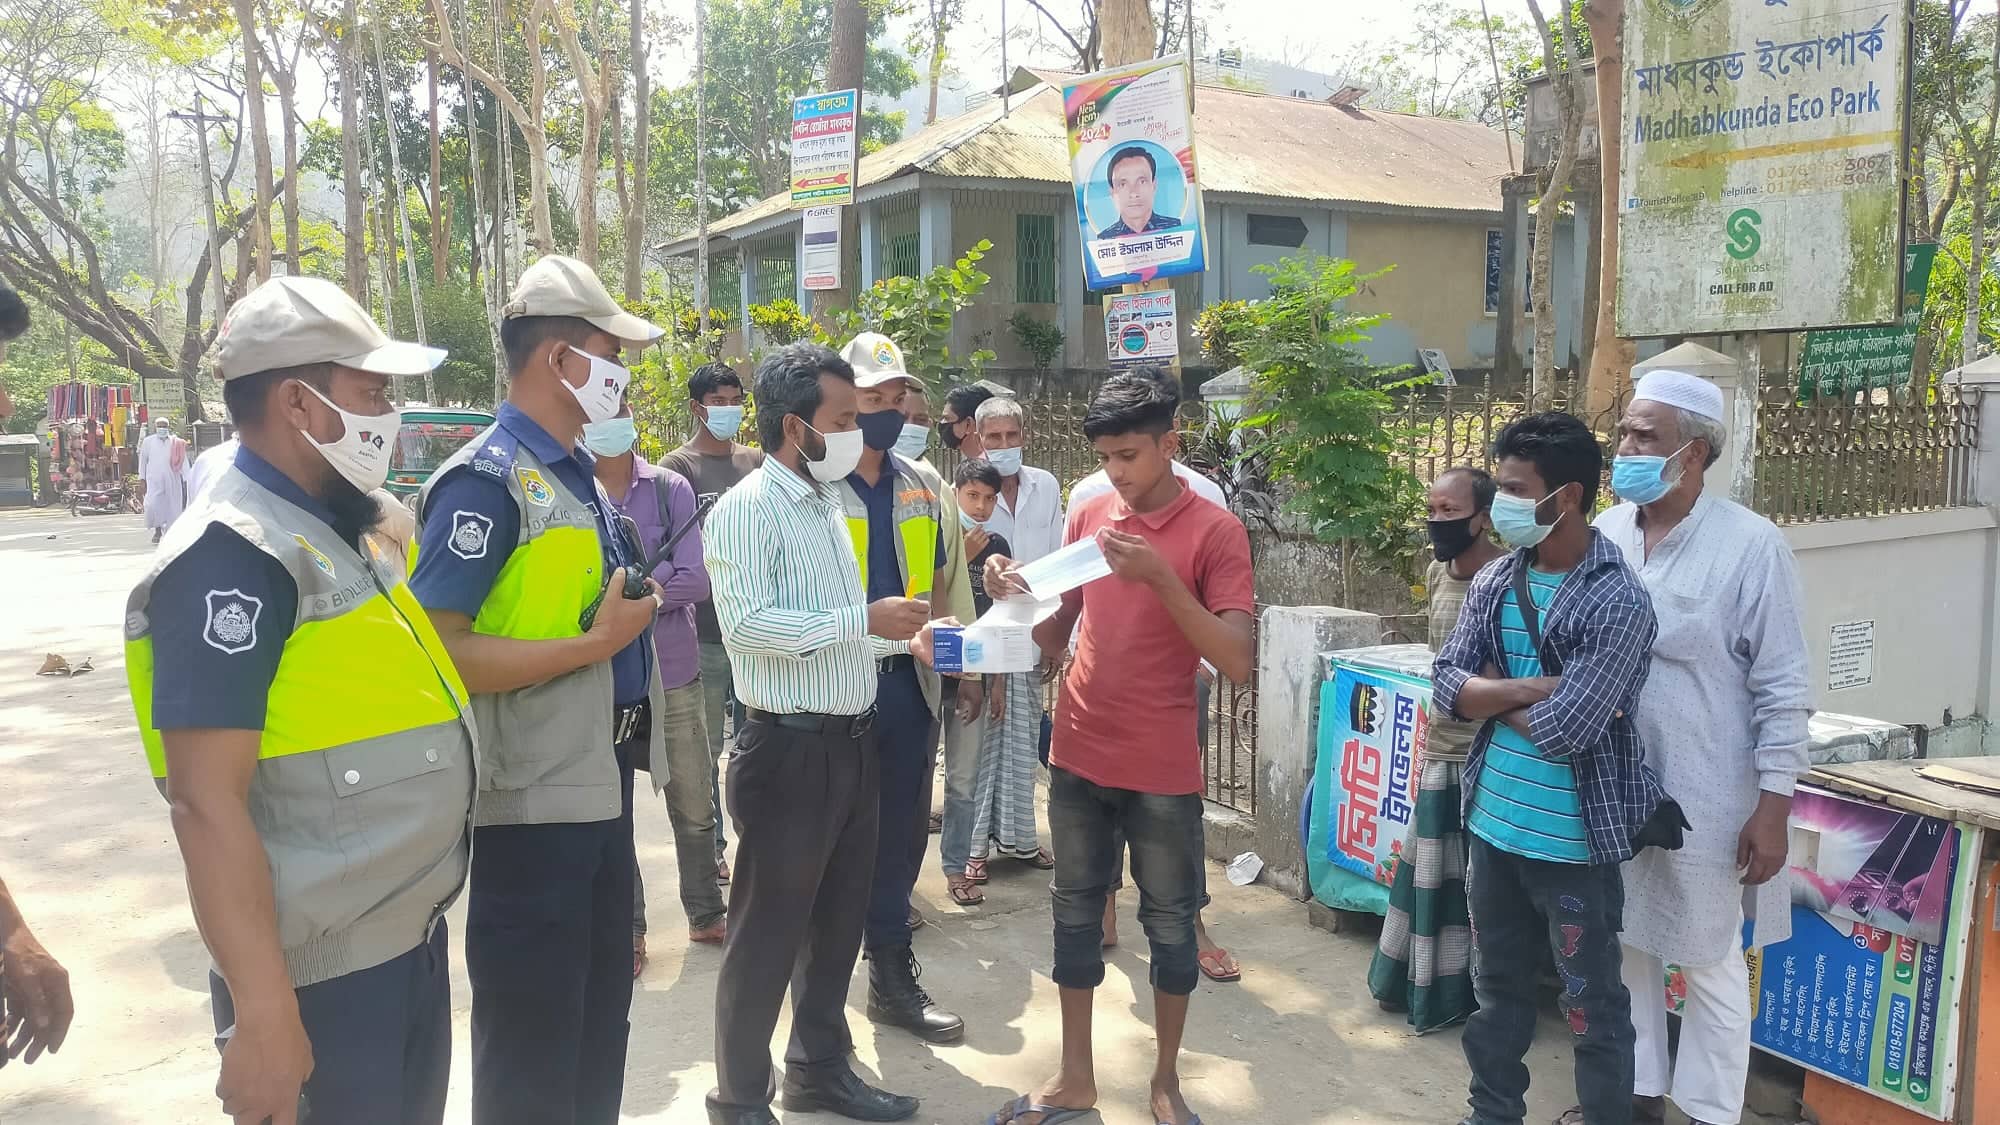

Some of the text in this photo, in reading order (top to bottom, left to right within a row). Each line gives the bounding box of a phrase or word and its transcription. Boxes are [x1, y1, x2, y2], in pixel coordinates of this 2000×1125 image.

[1634, 14, 1889, 97] মাধবকুন্ড ইকোপার্ক
[1080, 127, 1107, 141] 2021
[1634, 80, 1881, 144] Madhabkunda Eco Park
[1097, 247, 1116, 259] মোঃ
[1119, 240, 1153, 256] ইসলাম
[1154, 235, 1184, 249] উদ্দিন
[1710, 281, 1773, 295] CALL FOR AD
[1380, 692, 1414, 826] ট্রাভেলস
[1337, 739, 1381, 864] সিটি
[1792, 985, 1808, 1037] ভিসা প্রসেসিং
[1824, 996, 1839, 1049] হোটেল বুকিং
[1858, 1000, 1872, 1018] স্লিপ
[1888, 1000, 1905, 1070] 01819-677204
[1839, 1021, 1852, 1055] ইউরোপ
[1854, 1021, 1868, 1061] মেডিকেল
